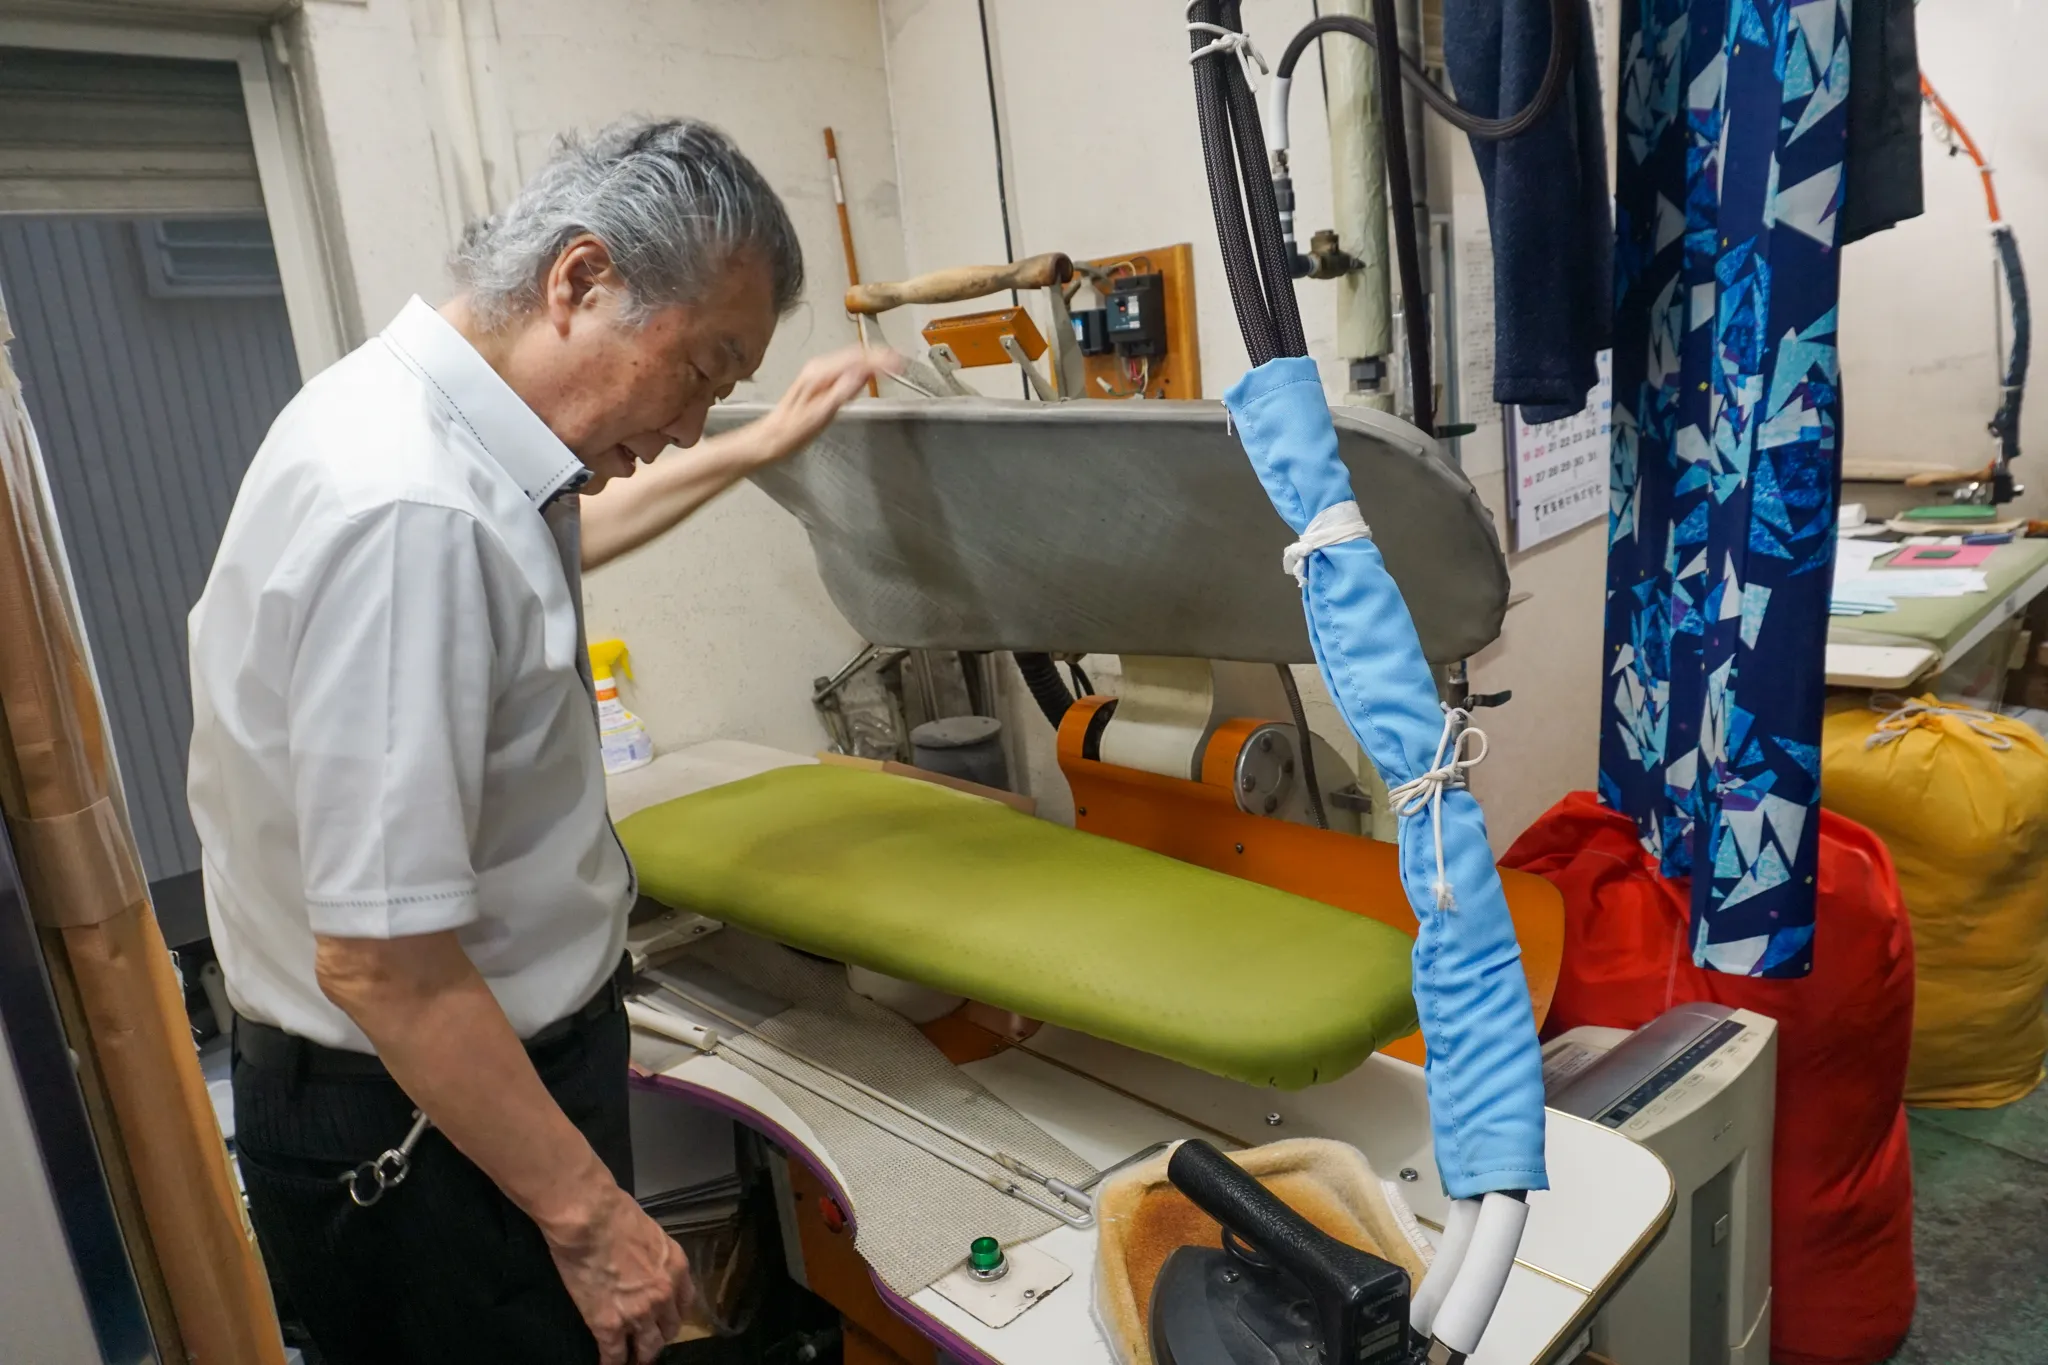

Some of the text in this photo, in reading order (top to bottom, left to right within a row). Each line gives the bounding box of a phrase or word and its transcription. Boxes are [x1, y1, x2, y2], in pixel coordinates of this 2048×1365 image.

[1534, 445, 1545, 458] 20
[1548, 441, 1557, 452] 21
[1560, 435, 1570, 448] 22
[1572, 431, 1583, 444] 23
[1585, 427, 1597, 439] 24
[1523, 451, 1597, 488] 26 27 28 29 30 31
